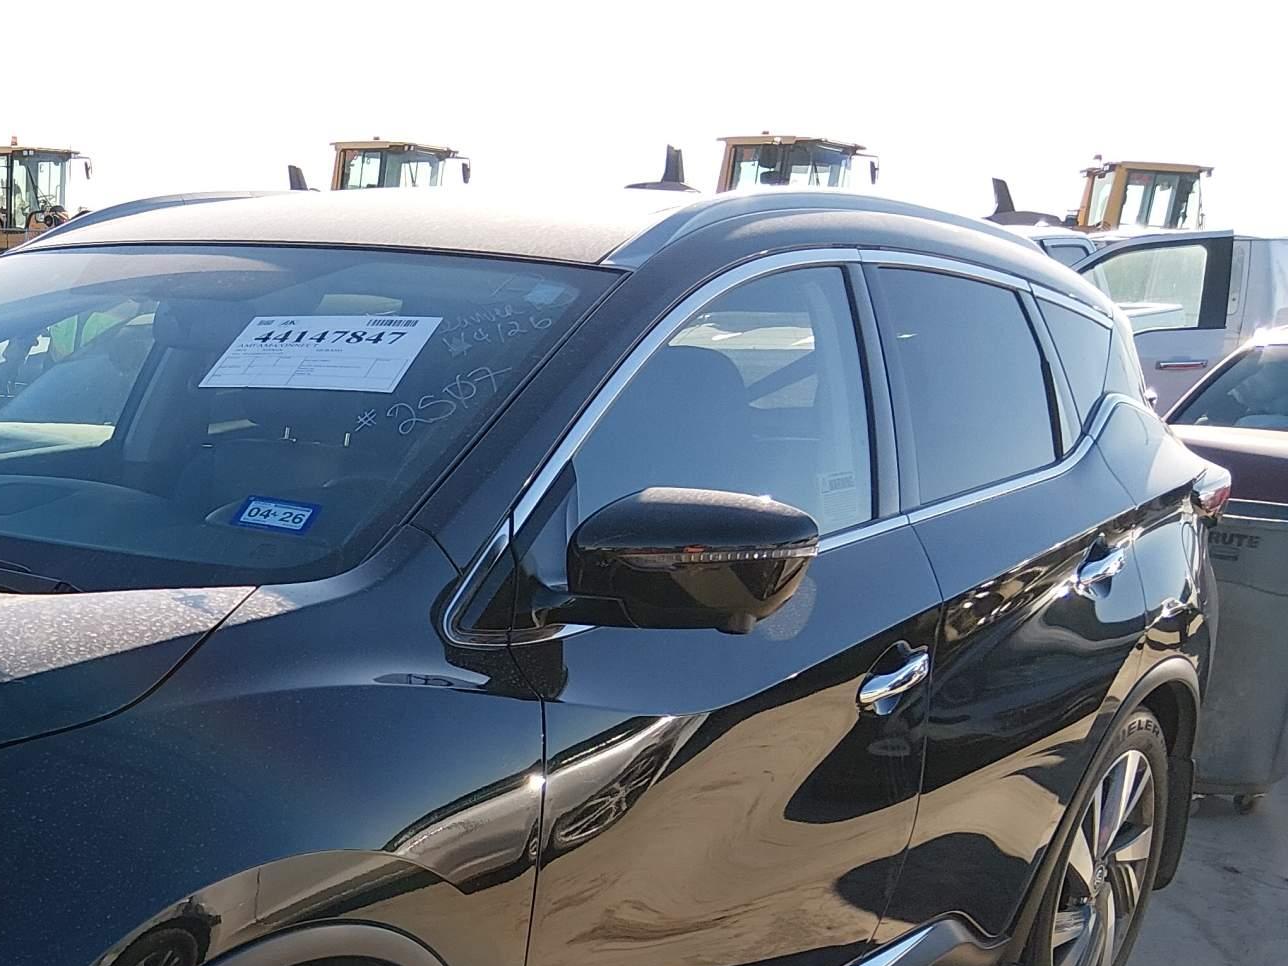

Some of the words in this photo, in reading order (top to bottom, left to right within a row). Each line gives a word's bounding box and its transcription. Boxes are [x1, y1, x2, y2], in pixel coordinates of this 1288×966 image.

[254, 329, 407, 345] 44147847
[247, 507, 272, 519] 04
[279, 511, 305, 525] 26
[1208, 531, 1261, 548] RUTE
